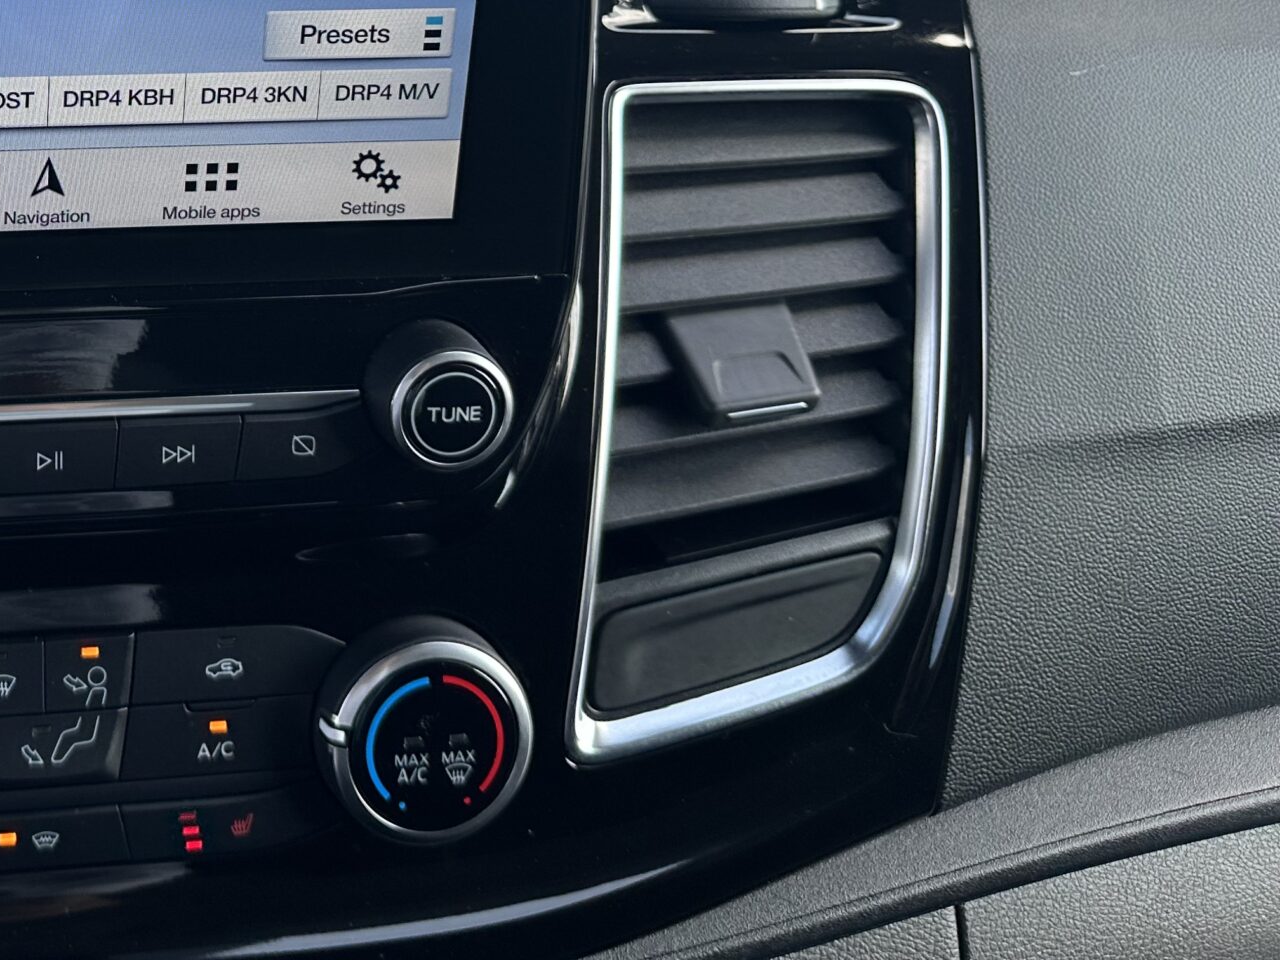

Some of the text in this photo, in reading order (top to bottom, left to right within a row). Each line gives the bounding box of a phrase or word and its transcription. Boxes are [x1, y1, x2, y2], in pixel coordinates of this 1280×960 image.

[299, 25, 391, 47] Presets
[62, 88, 175, 108] DRP4 KBH
[200, 85, 309, 105] DRP4 3KN
[334, 82, 441, 103] DRP4 M/V
[3, 208, 91, 227] Navigation
[162, 205, 261, 221] Mobile apps
[340, 200, 406, 218] Settings
[427, 406, 482, 423] TUNE
[197, 741, 235, 760] A/C
[441, 749, 476, 764] MAX
[394, 753, 430, 768] MAX
[397, 767, 429, 784] A/C
